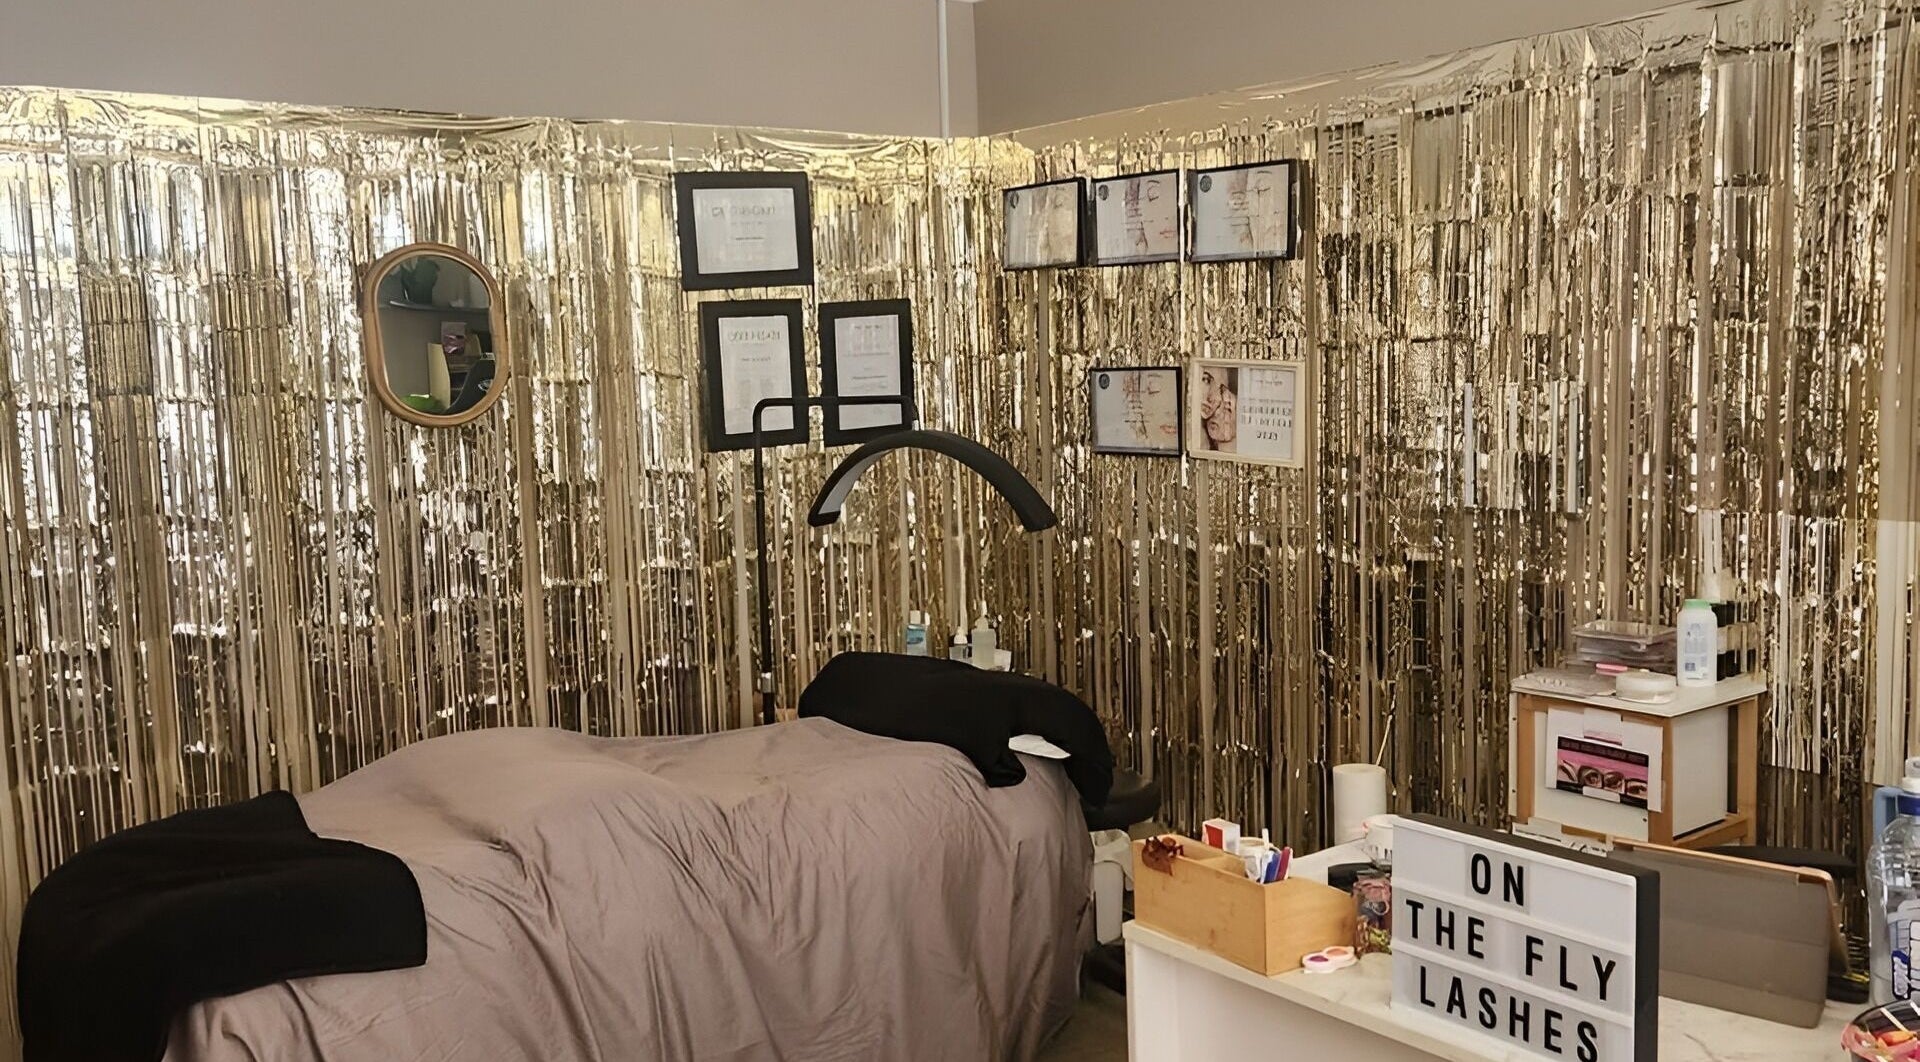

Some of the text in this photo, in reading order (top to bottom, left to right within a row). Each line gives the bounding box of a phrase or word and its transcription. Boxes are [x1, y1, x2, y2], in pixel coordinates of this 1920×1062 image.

[1471, 853, 1524, 907] ON
[1405, 899, 1616, 1001] THE FLY
[1420, 966, 1598, 1062] LASHES
